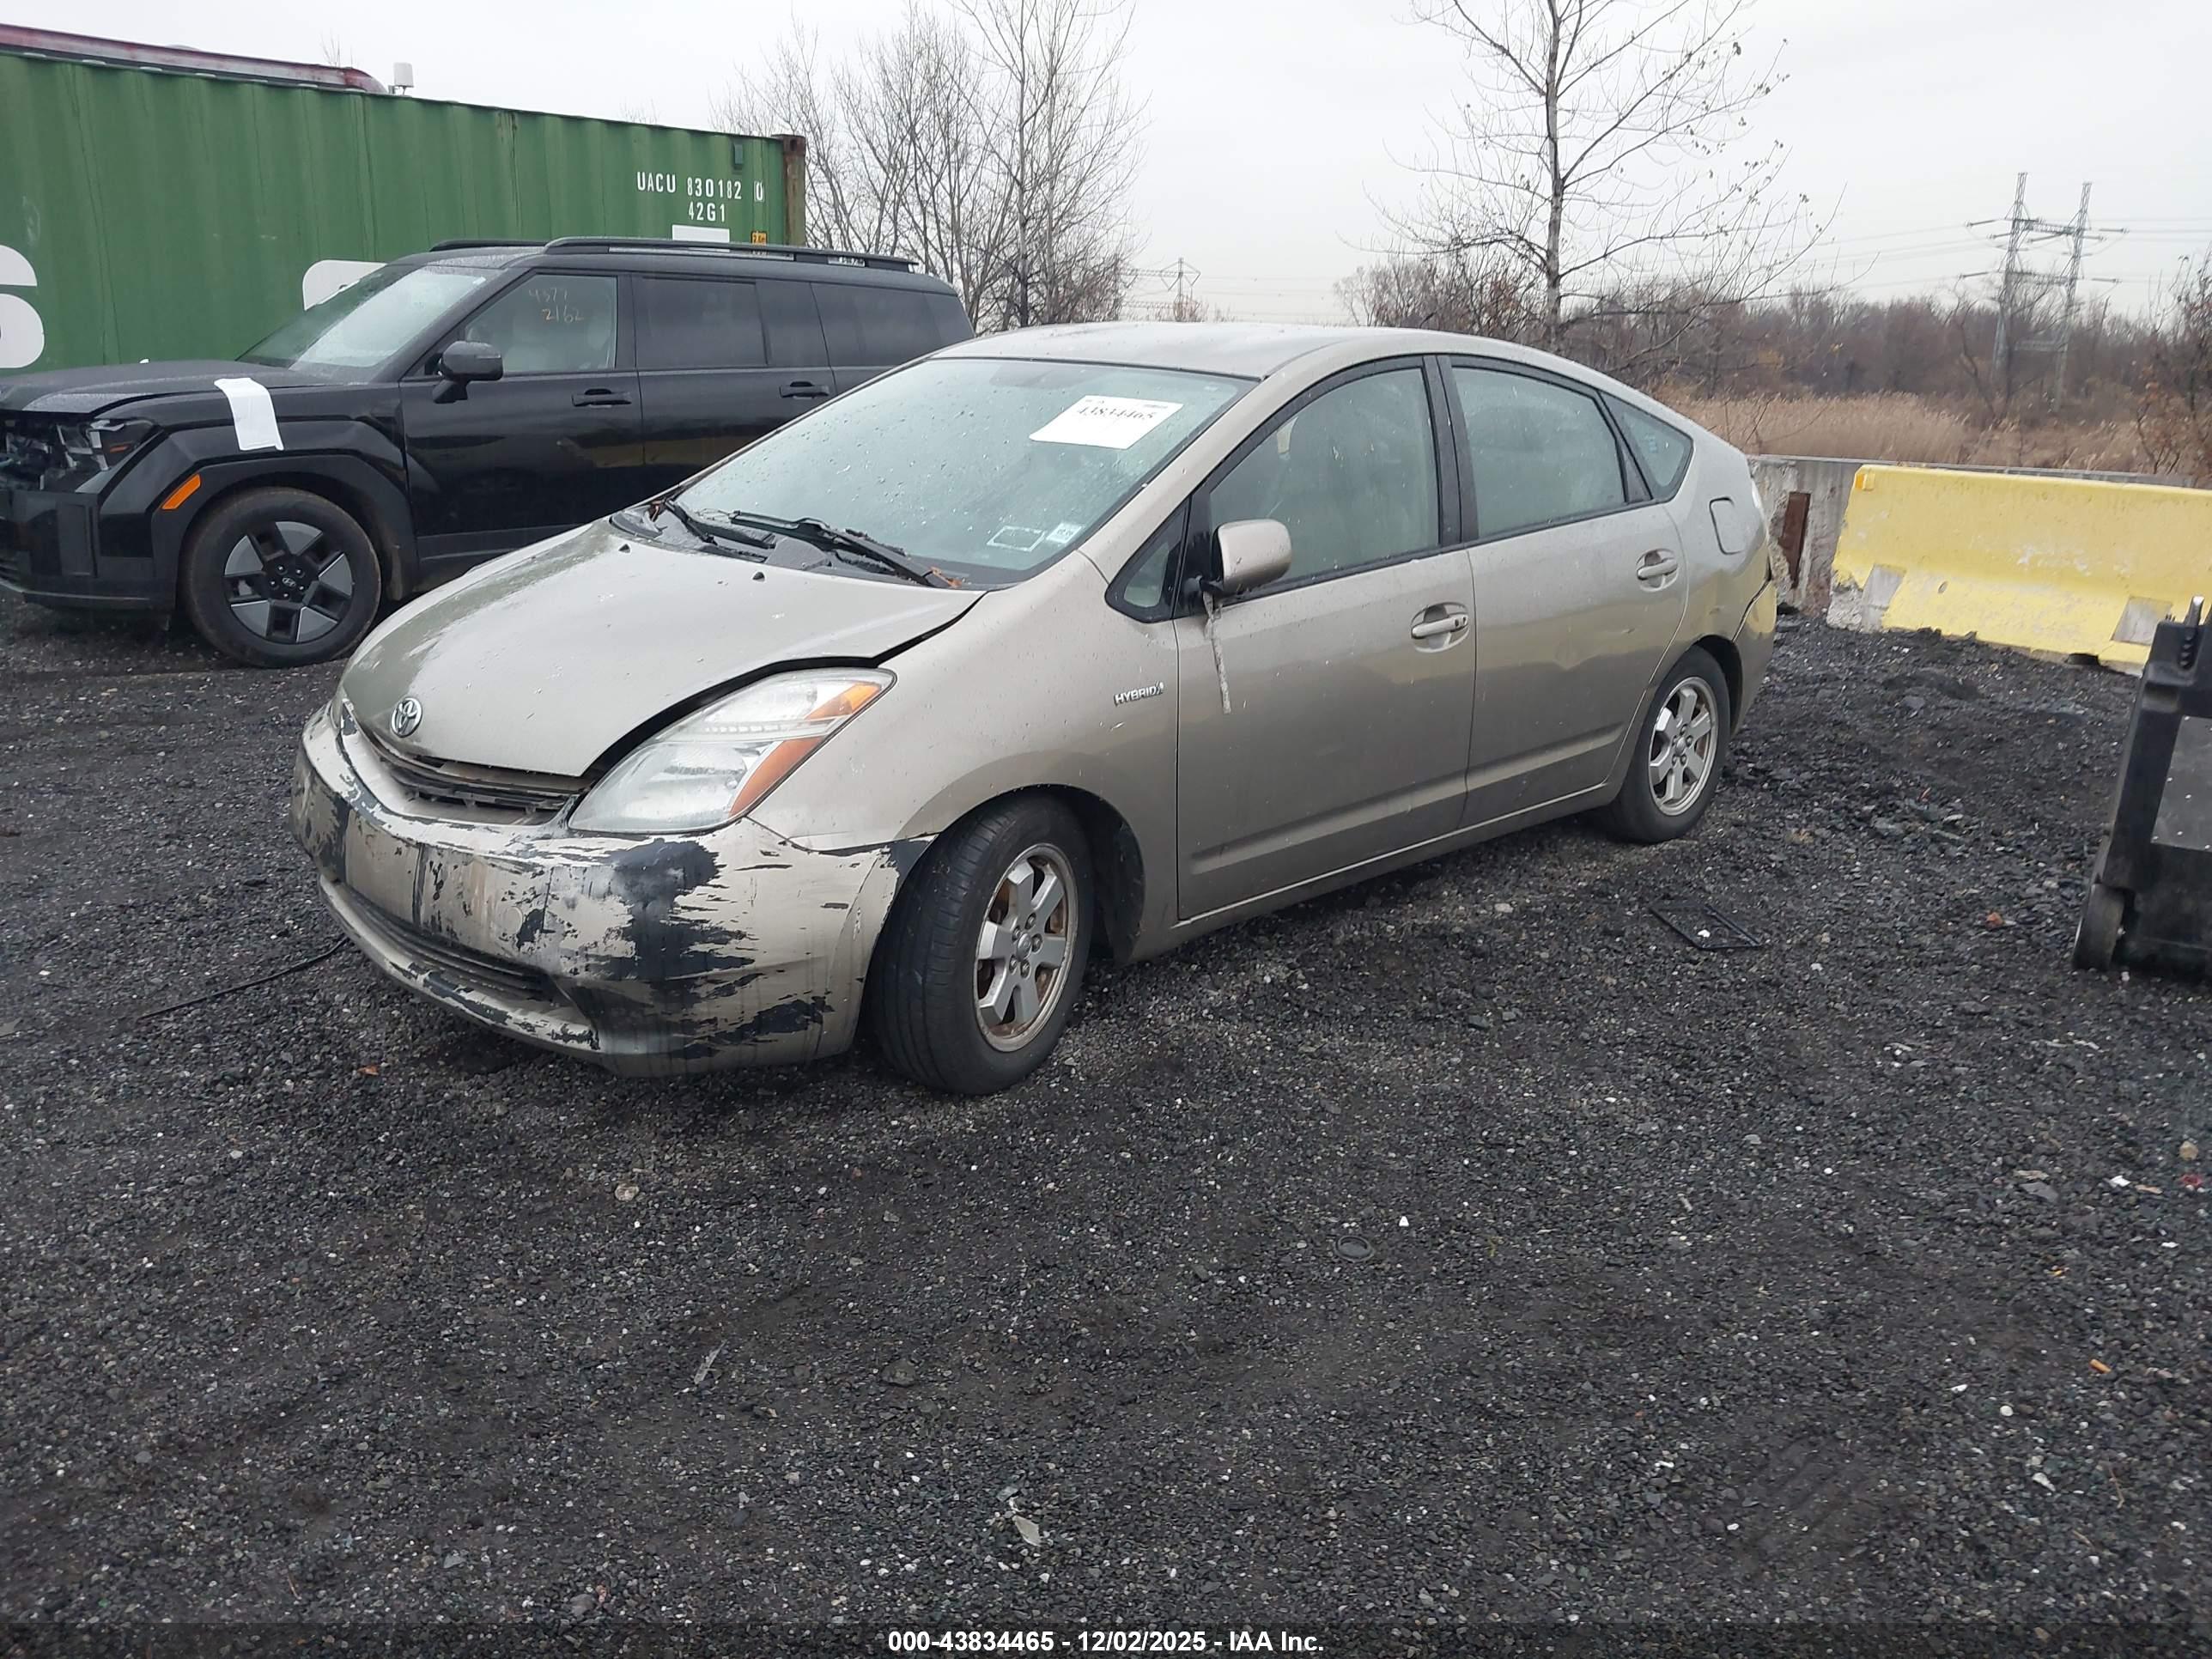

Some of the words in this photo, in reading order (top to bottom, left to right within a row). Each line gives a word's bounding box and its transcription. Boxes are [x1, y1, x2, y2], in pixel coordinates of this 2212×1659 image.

[636, 171, 677, 193] UACU
[687, 177, 742, 200] 830182
[688, 202, 726, 222] 42G1
[1115, 686, 1157, 704] HYBRID
